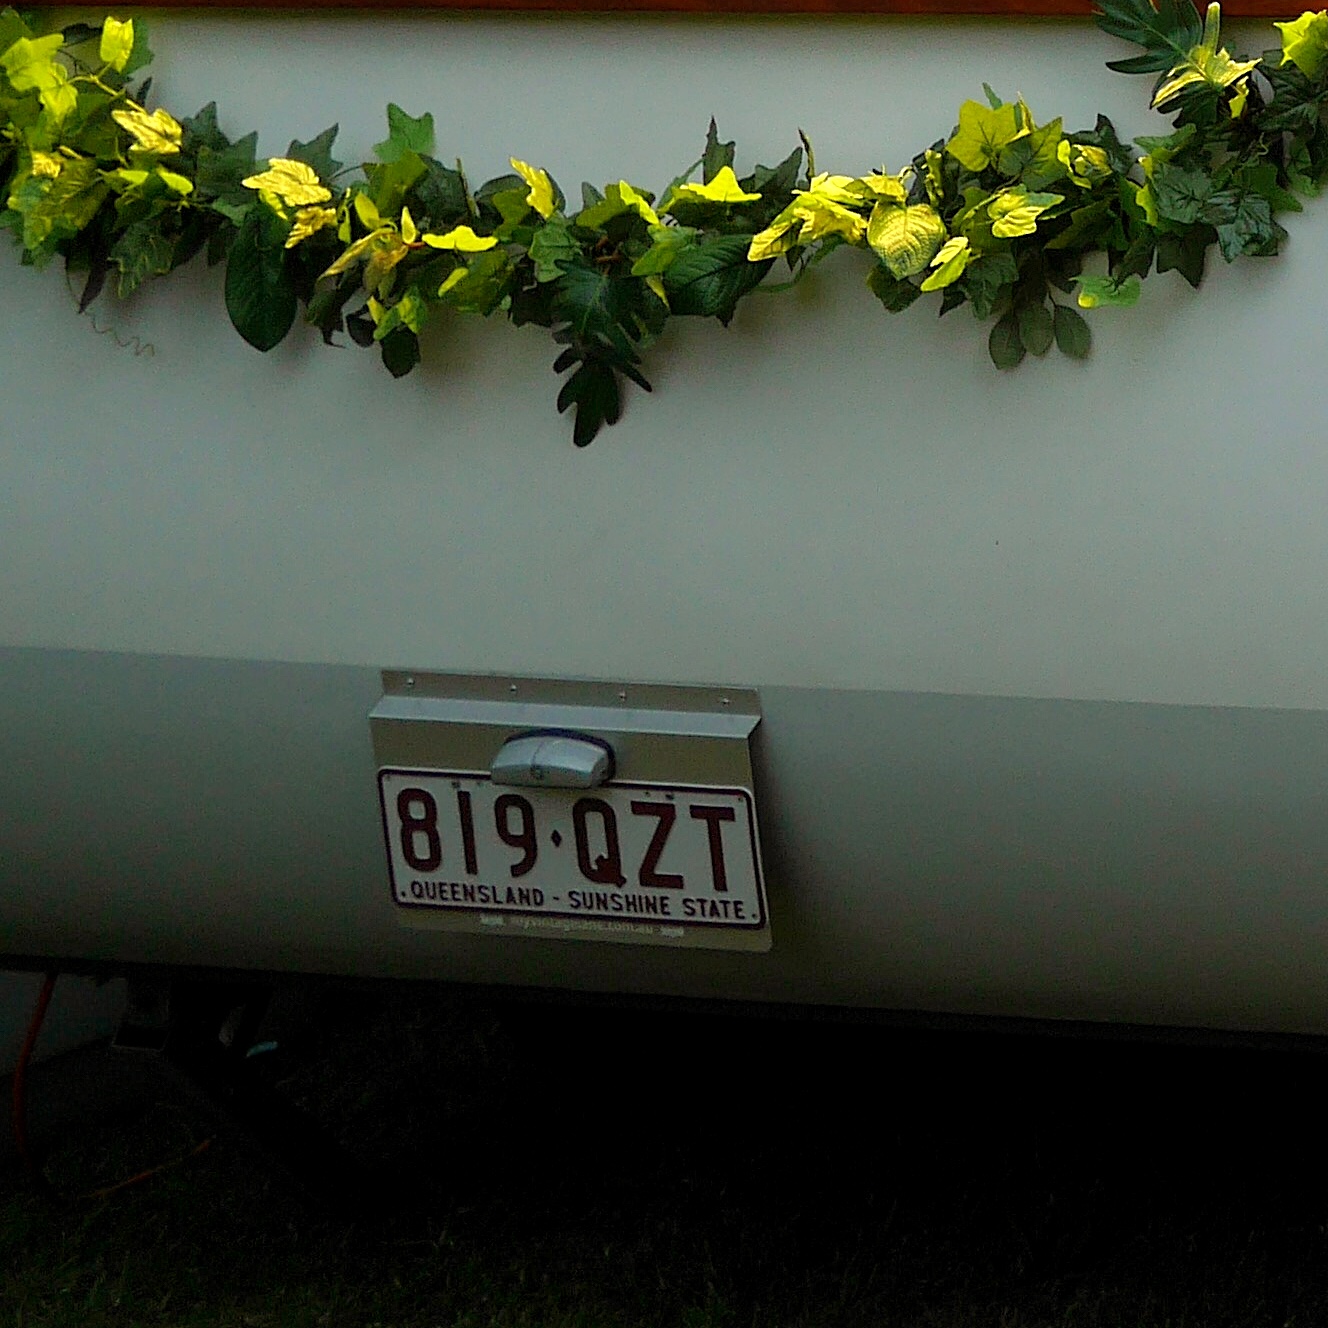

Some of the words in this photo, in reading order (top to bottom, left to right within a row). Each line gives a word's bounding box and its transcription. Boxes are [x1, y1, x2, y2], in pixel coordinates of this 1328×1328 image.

[411, 880, 544, 907] QUEENSLAND
[568, 889, 671, 916] SUNSHINE
[682, 897, 745, 920] STATE
